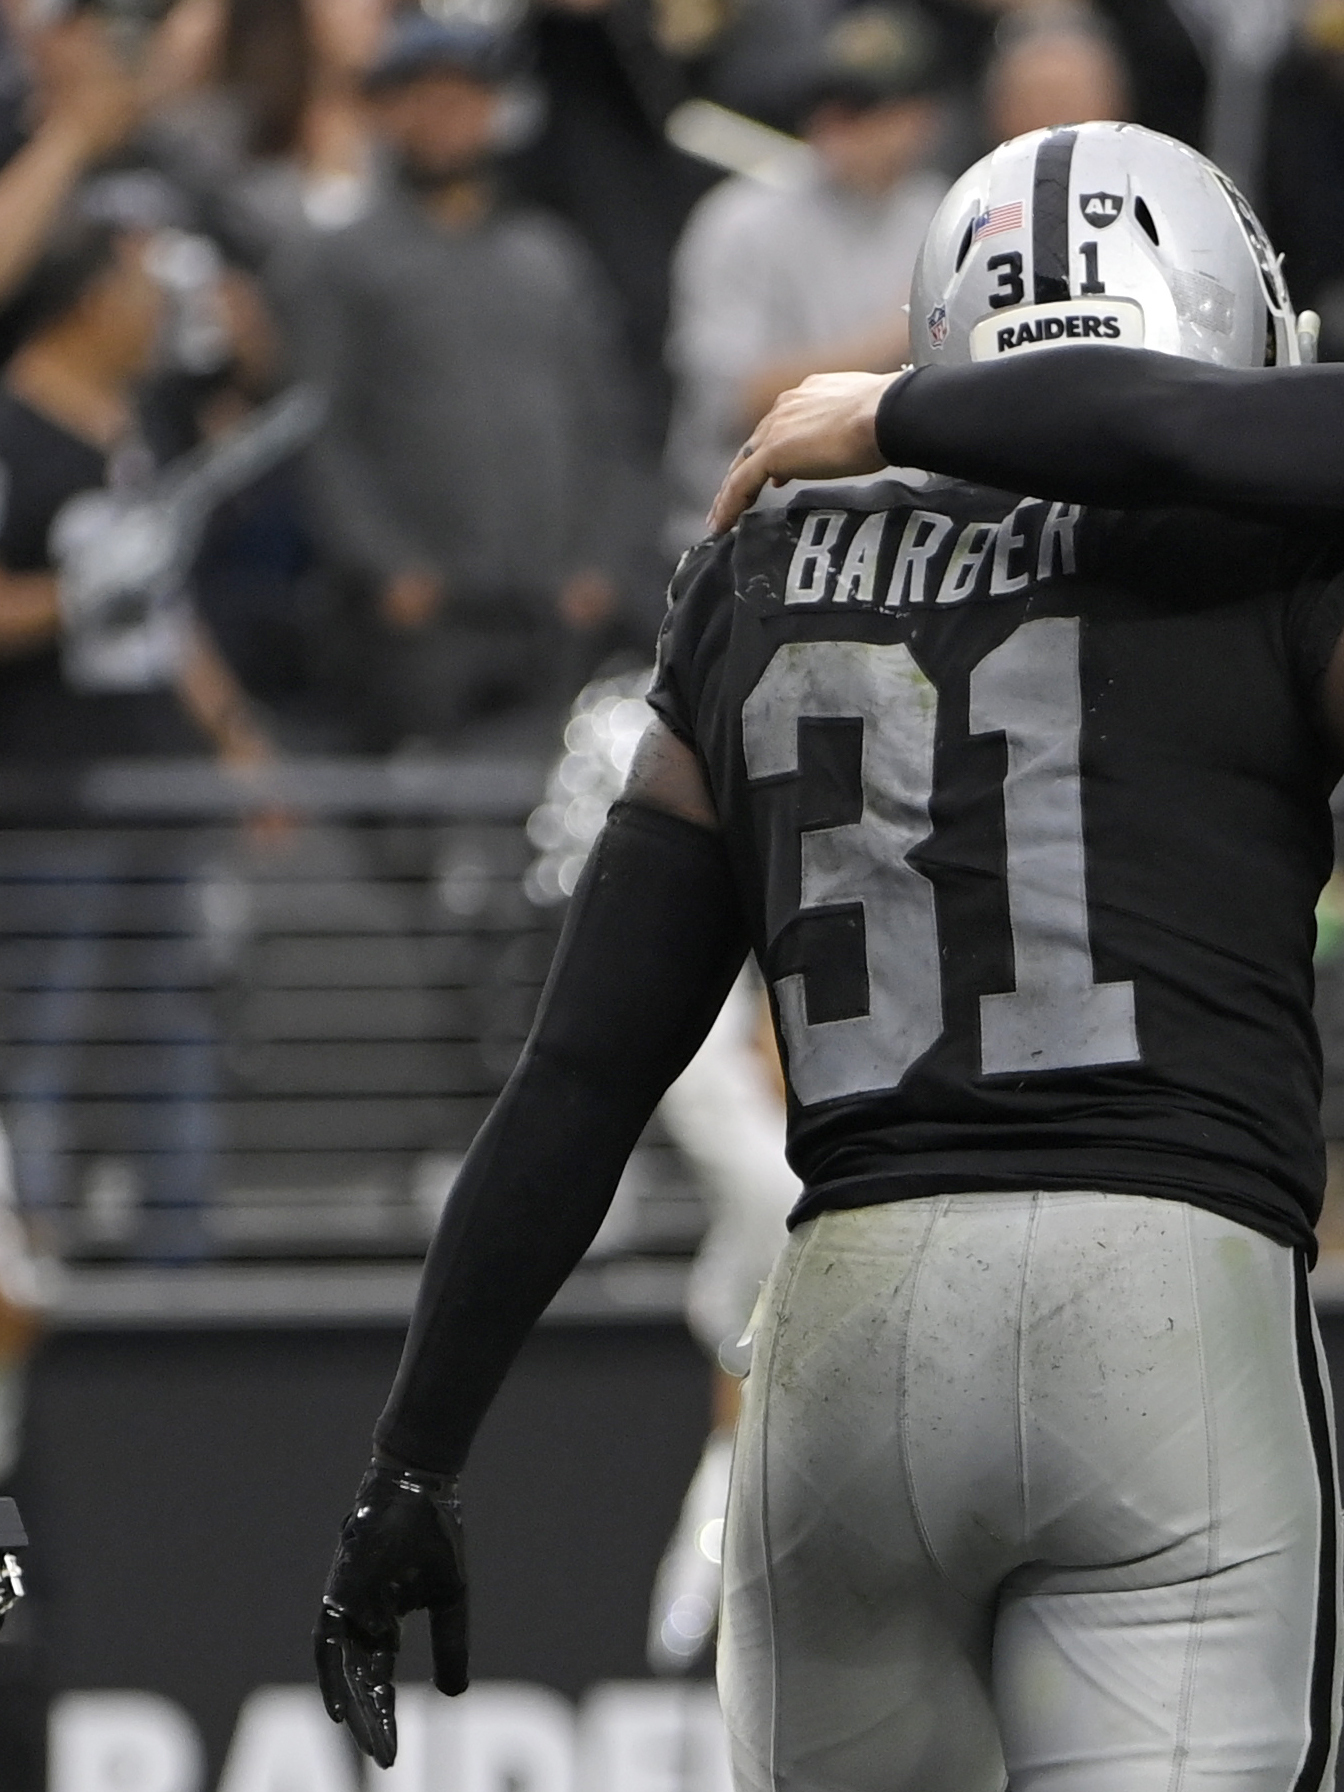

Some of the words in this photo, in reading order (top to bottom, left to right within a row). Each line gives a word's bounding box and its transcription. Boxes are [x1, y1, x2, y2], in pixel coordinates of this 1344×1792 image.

[1084, 198, 1118, 215] AL
[997, 315, 1121, 353] RAIDERS
[784, 497, 1082, 606] BARBER
[742, 617, 1141, 1107] 31
